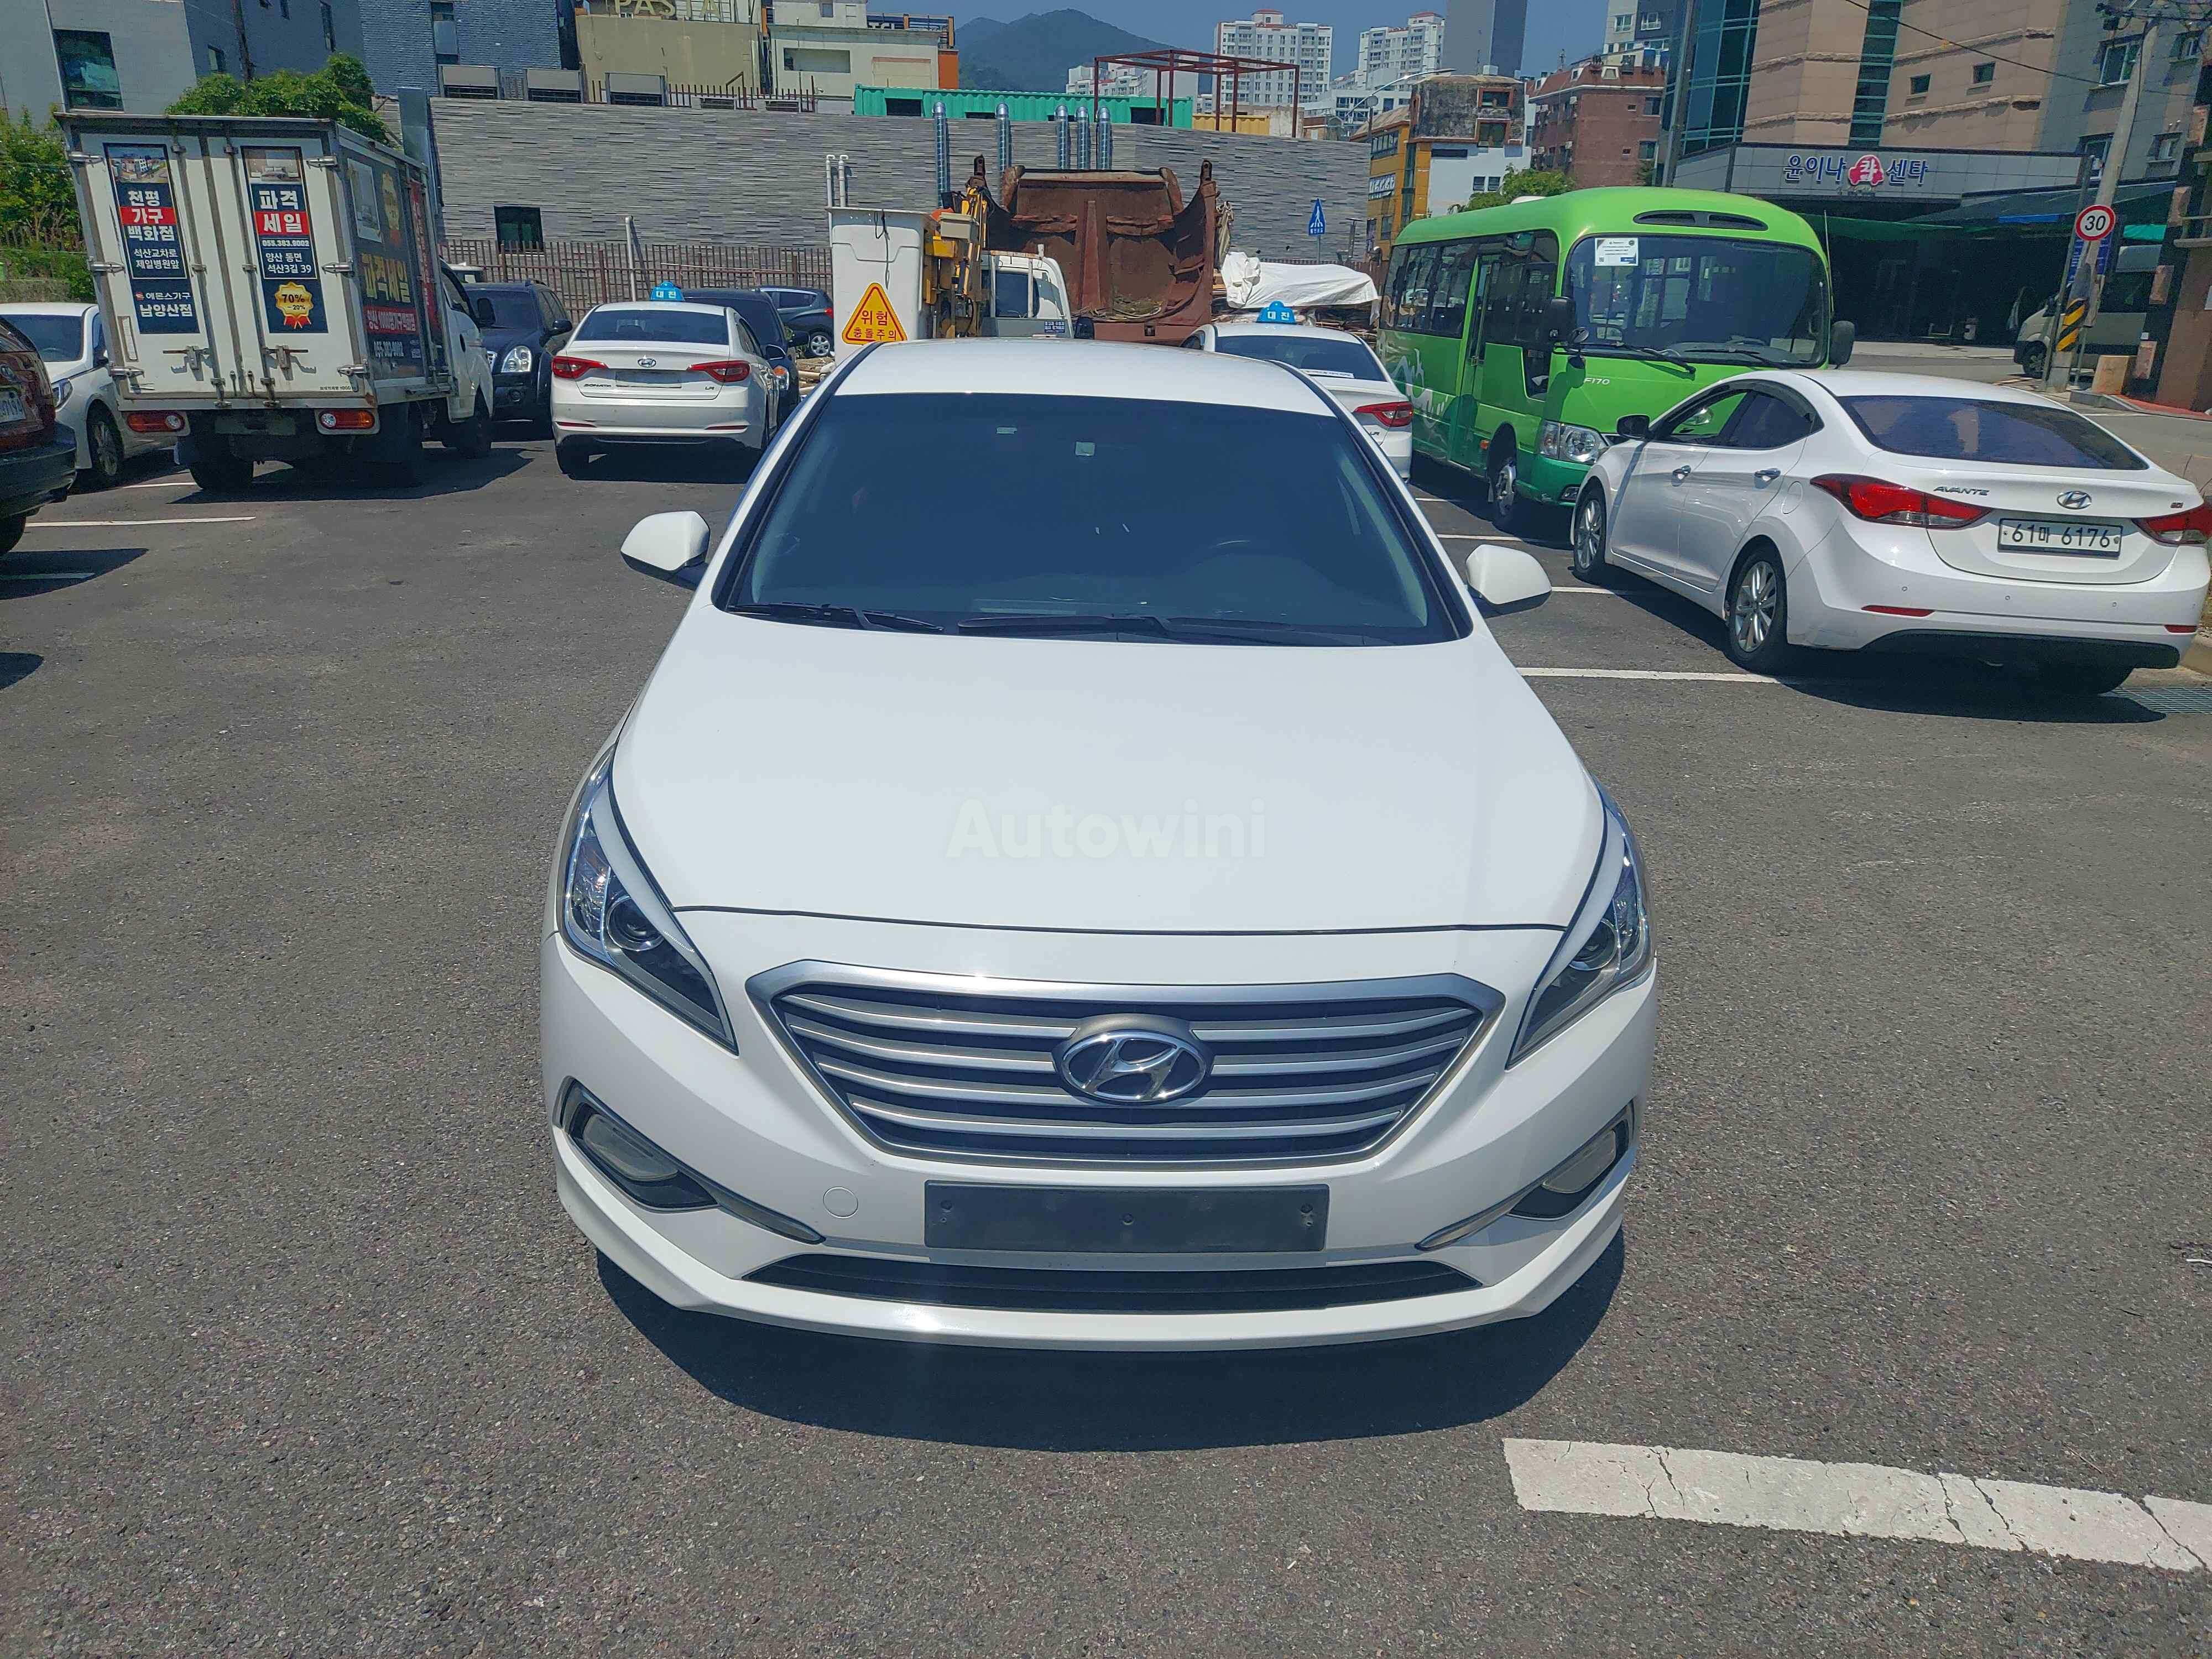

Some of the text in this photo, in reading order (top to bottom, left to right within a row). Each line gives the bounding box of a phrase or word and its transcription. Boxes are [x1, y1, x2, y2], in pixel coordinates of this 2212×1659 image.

[128, 190, 160, 206] 천평
[259, 190, 299, 210] 파격
[132, 208, 164, 224] 가구
[264, 213, 302, 232] 세일
[2085, 215, 2106, 231] 30
[127, 226, 175, 241] 백화점
[134, 249, 179, 258] 석산교차로
[265, 253, 303, 262] 양산 동면
[136, 259, 180, 269] 제일병원앞
[268, 264, 311, 274] 석산3길 39
[281, 294, 304, 303] 70%
[139, 304, 193, 317] 남양산점
[861, 310, 888, 326] 위험
[854, 327, 896, 341] 충돌주의
[1933, 486, 1990, 496] AVANTE
[2012, 524, 2110, 548] 61마 6176
